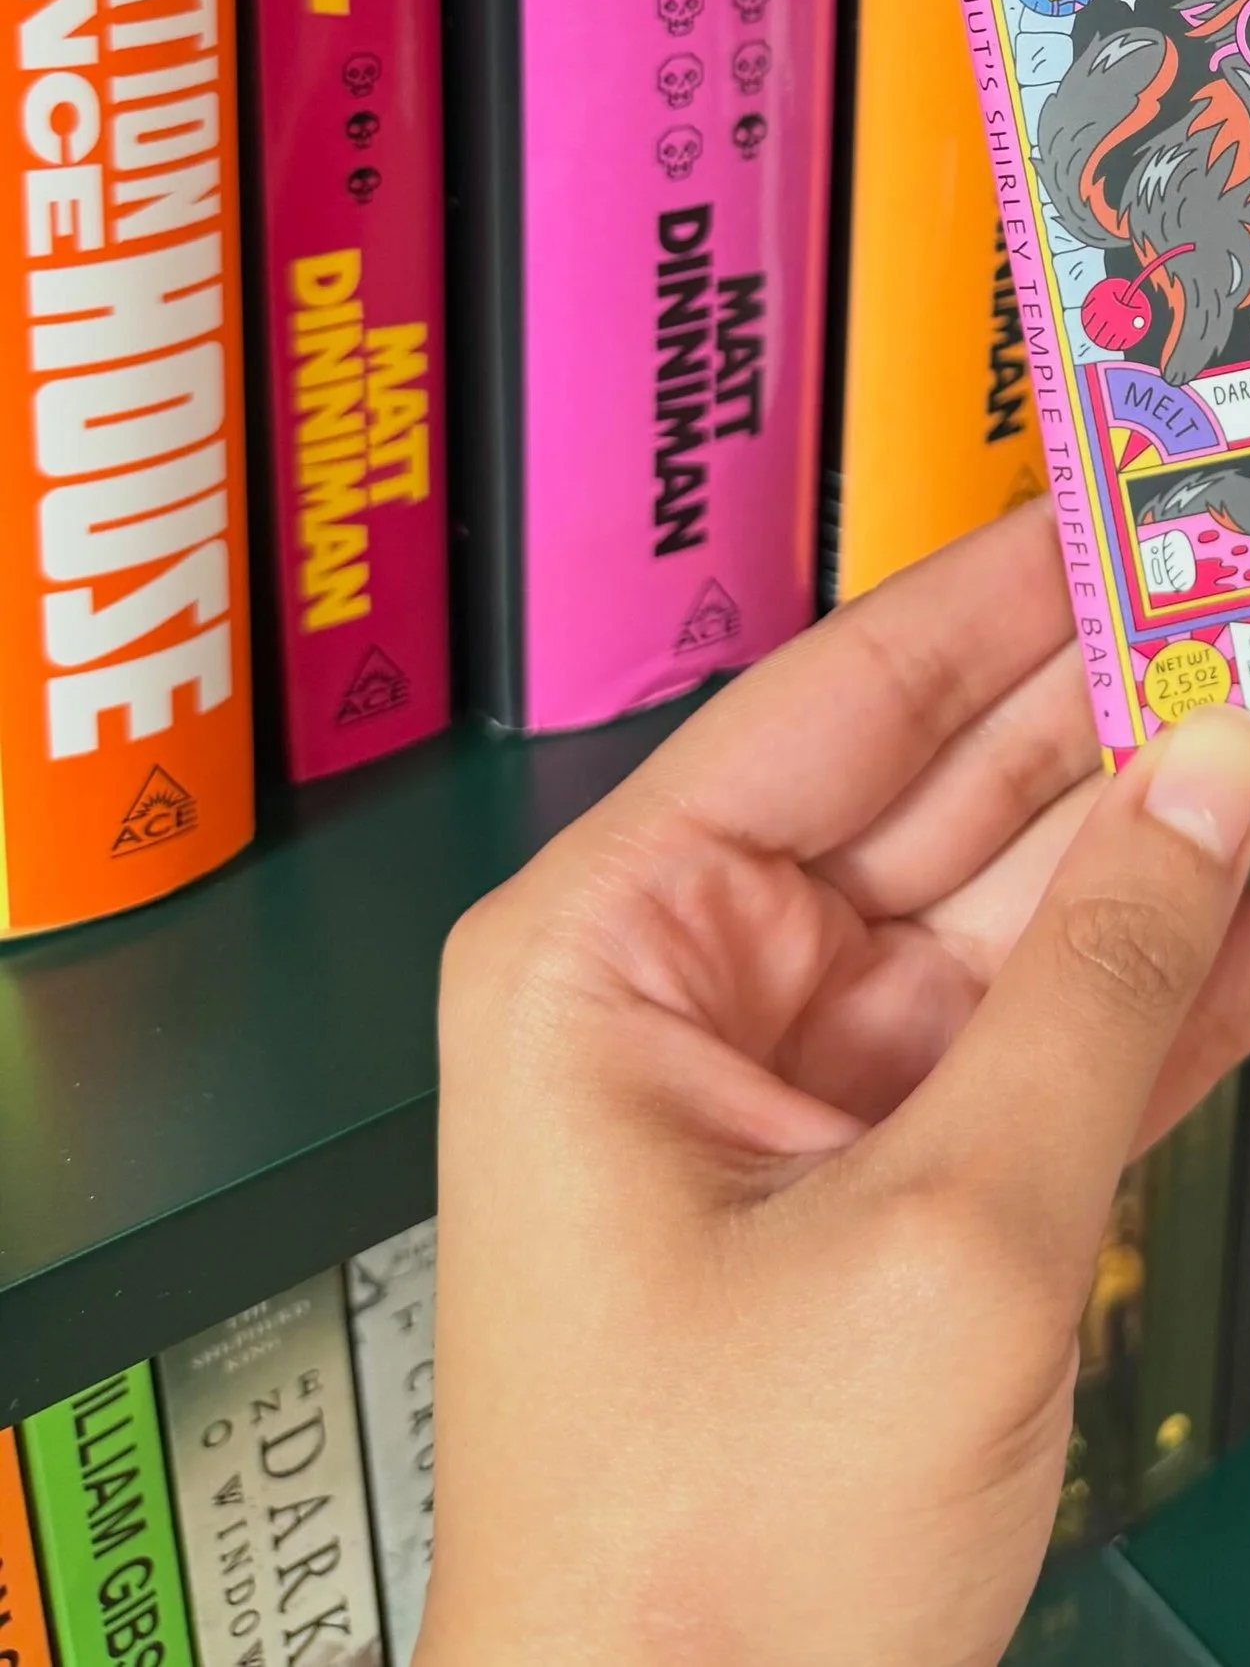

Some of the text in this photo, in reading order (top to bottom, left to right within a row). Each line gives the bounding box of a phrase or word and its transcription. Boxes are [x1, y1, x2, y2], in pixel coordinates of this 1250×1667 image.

[287, 249, 371, 634] DINNIMAN
[362, 325, 430, 504] MATT
[652, 203, 714, 560] DINNIMAN
[711, 272, 768, 441] MATT
[985, 109, 1032, 261] SHIRLEY
[1019, 278, 1063, 424] TEMPLE
[1049, 441, 1097, 599] TRUFFLE
[1081, 617, 1113, 690] BAR
[1121, 380, 1199, 441] MELT
[30, 244, 232, 760] HOUSE
[1155, 648, 1211, 674] NET WT
[1156, 672, 1193, 700] 2.5
[112, 800, 198, 851] ACE
[201, 1368, 324, 1450] ONE
[260, 1407, 353, 1667] DARK
